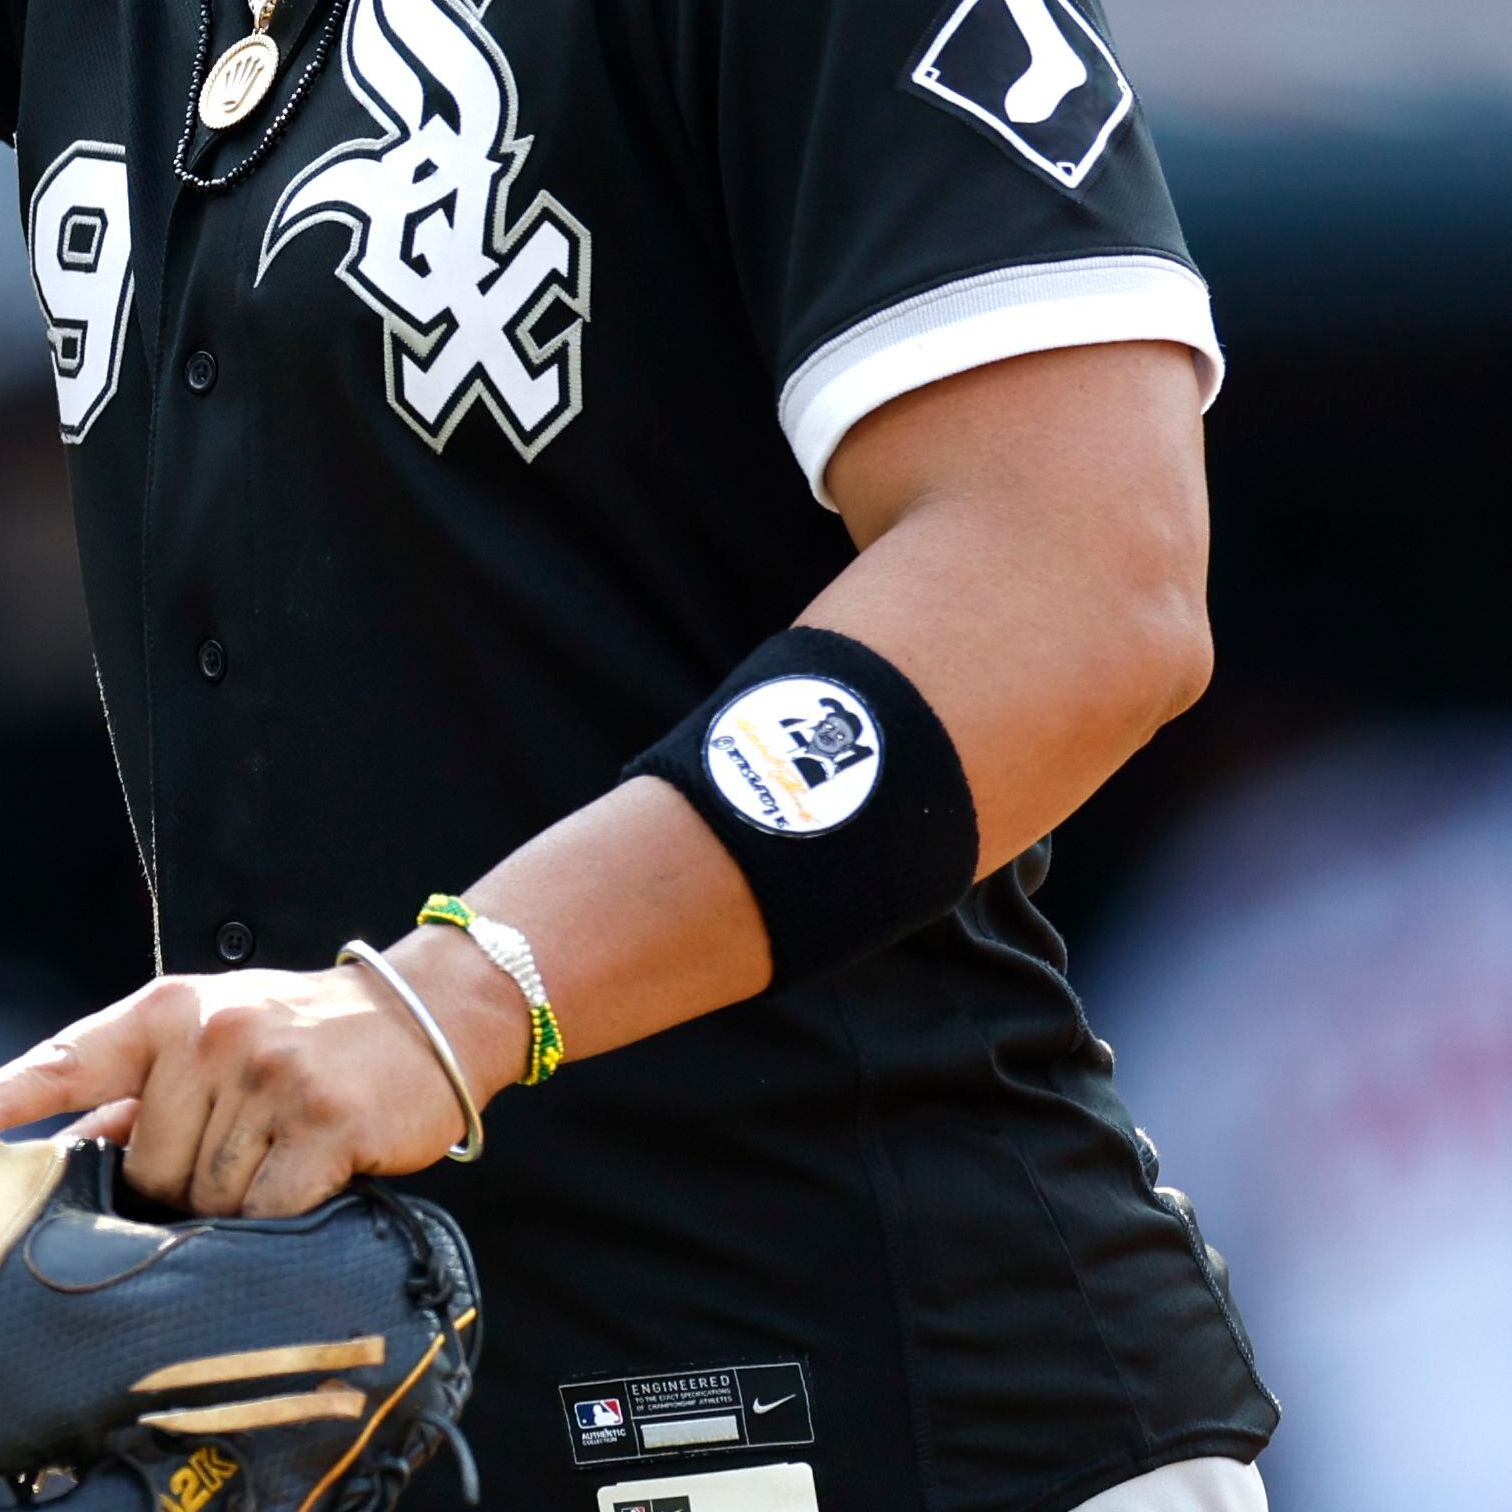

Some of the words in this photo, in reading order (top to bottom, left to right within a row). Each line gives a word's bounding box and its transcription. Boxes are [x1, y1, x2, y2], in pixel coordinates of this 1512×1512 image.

[28, 139, 134, 445] 9
[631, 1374, 731, 1396] ENGINEERED
[644, 1394, 657, 1403] THE
[699, 1395, 733, 1405] ATHLETES
[581, 1428, 627, 1440] AUTHENTIC
[159, 1445, 239, 1512] 2K
